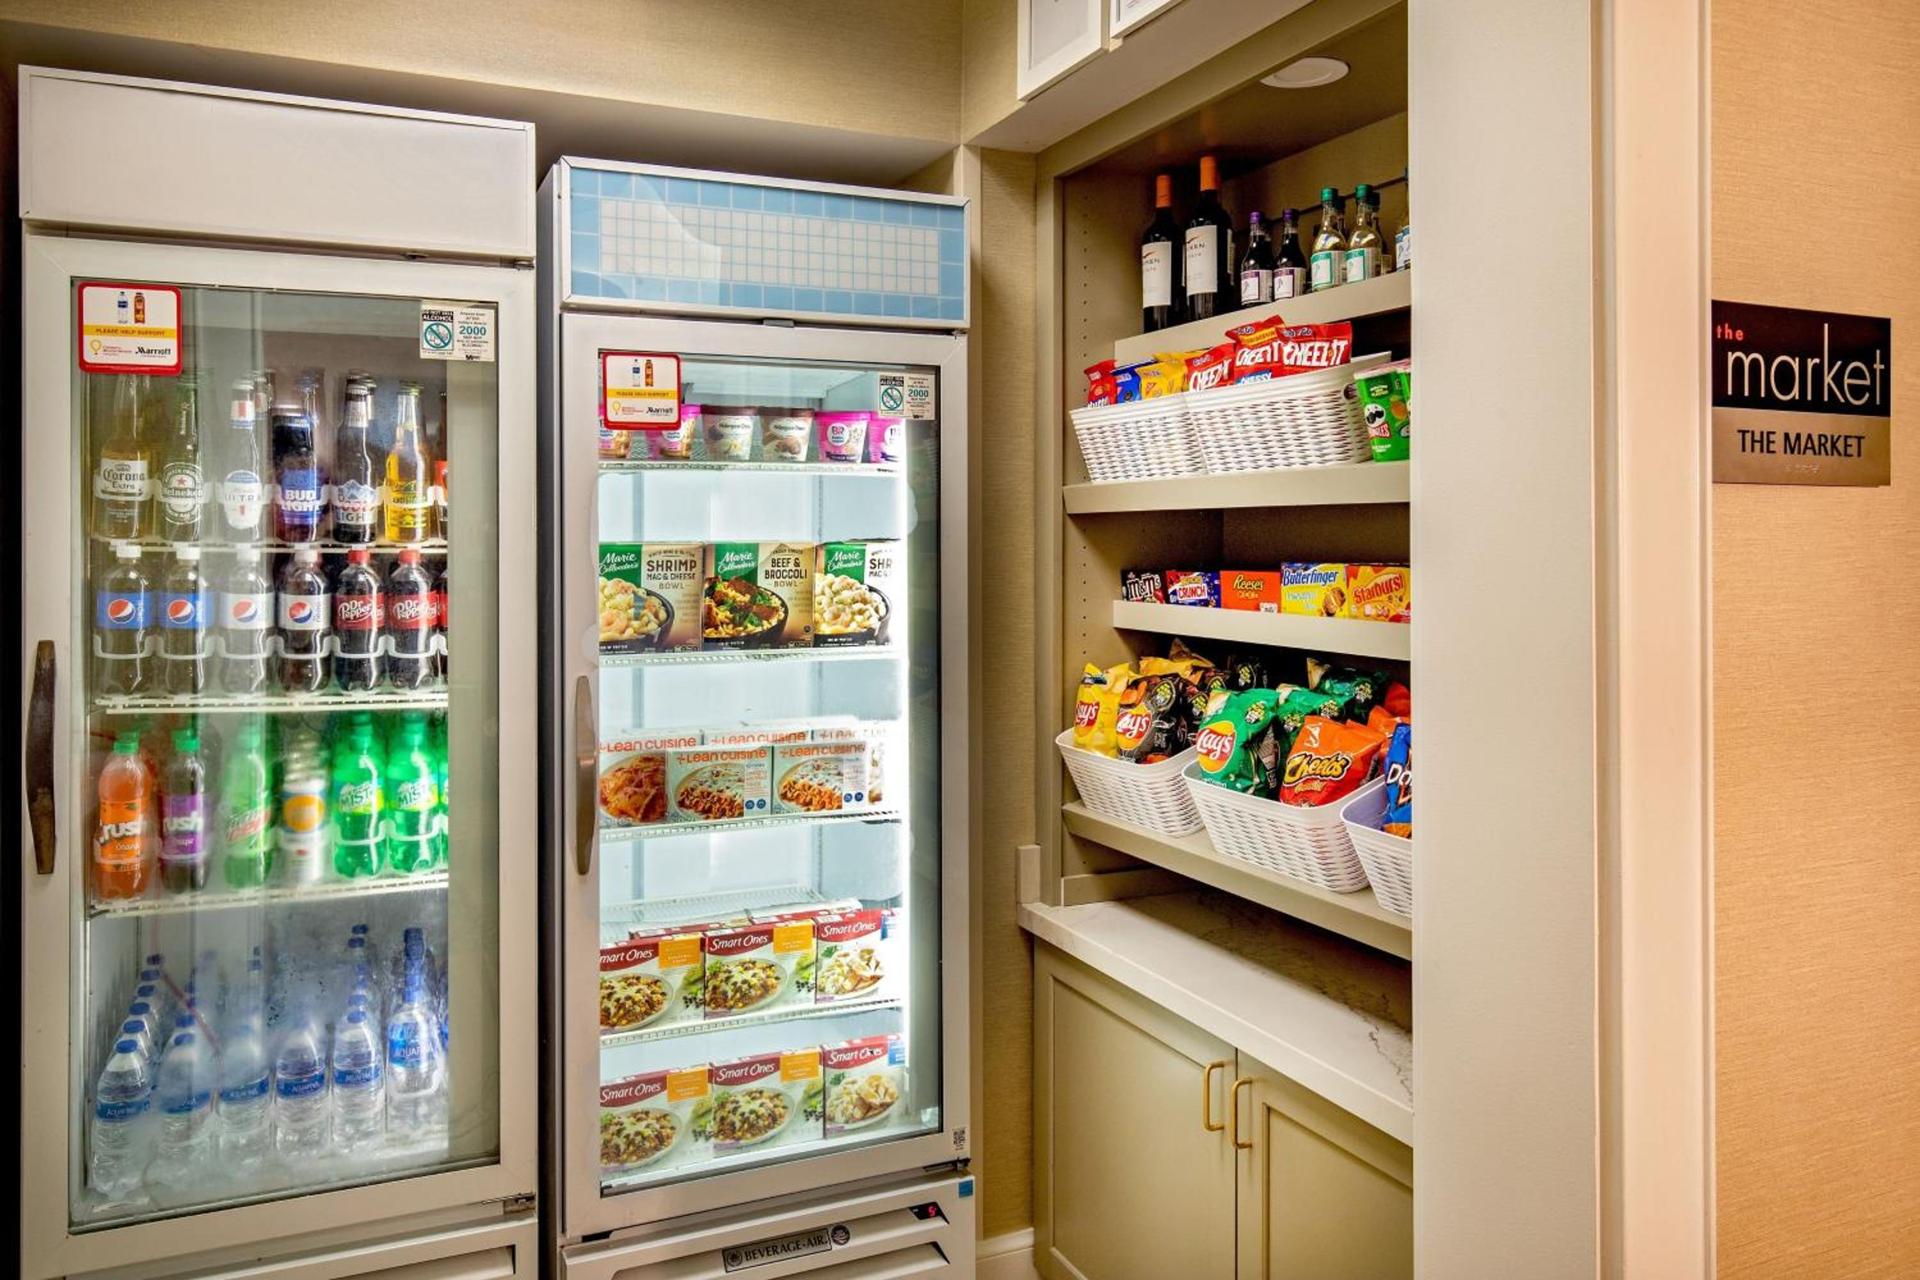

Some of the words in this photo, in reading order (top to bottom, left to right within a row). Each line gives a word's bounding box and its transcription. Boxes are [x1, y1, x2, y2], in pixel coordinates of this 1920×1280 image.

[95, 327, 119, 335] PLEASE
[458, 325, 487, 336] 2000
[1716, 323, 1745, 341] the
[135, 346, 171, 356] Marriott
[1727, 322, 1885, 406] market
[908, 388, 929, 398] 2000
[1737, 429, 1777, 454] THE
[1783, 432, 1866, 458] MARKET
[102, 468, 145, 482] Corona
[284, 489, 317, 501] BUD
[281, 500, 321, 512] LIGHT
[603, 552, 638, 563] Marie
[722, 551, 753, 562] Marie
[771, 557, 791, 568] BEEF
[793, 557, 801, 568] &
[831, 551, 861, 562] Marie
[646, 560, 697, 573] SHRIMP
[869, 558, 893, 570] SHR
[670, 572, 696, 580] CHEESE
[764, 569, 808, 579] BROCCOLI
[1282, 569, 1339, 587] Butterfinger
[658, 582, 685, 590] BOWL
[773, 580, 799, 588] BOWL
[1353, 573, 1405, 604] Starburst
[1178, 585, 1207, 599] CRUNCH
[349, 599, 364, 609] Dr
[338, 602, 373, 620] Pepper
[1116, 714, 1151, 739] Lay's
[607, 740, 643, 752] Lean
[1196, 728, 1234, 759] Lay's
[687, 751, 718, 763] Lean
[1386, 763, 1412, 786] DO
[821, 923, 851, 938] Smart
[709, 937, 742, 952] Smart
[743, 934, 769, 947] Ones
[600, 951, 625, 963] mart
[625, 948, 653, 962] Ones
[828, 1050, 859, 1065] Smart
[715, 1067, 749, 1082] Smart
[749, 1062, 776, 1077] Ones
[600, 1087, 634, 1103] Smart
[634, 1082, 662, 1097] Ones
